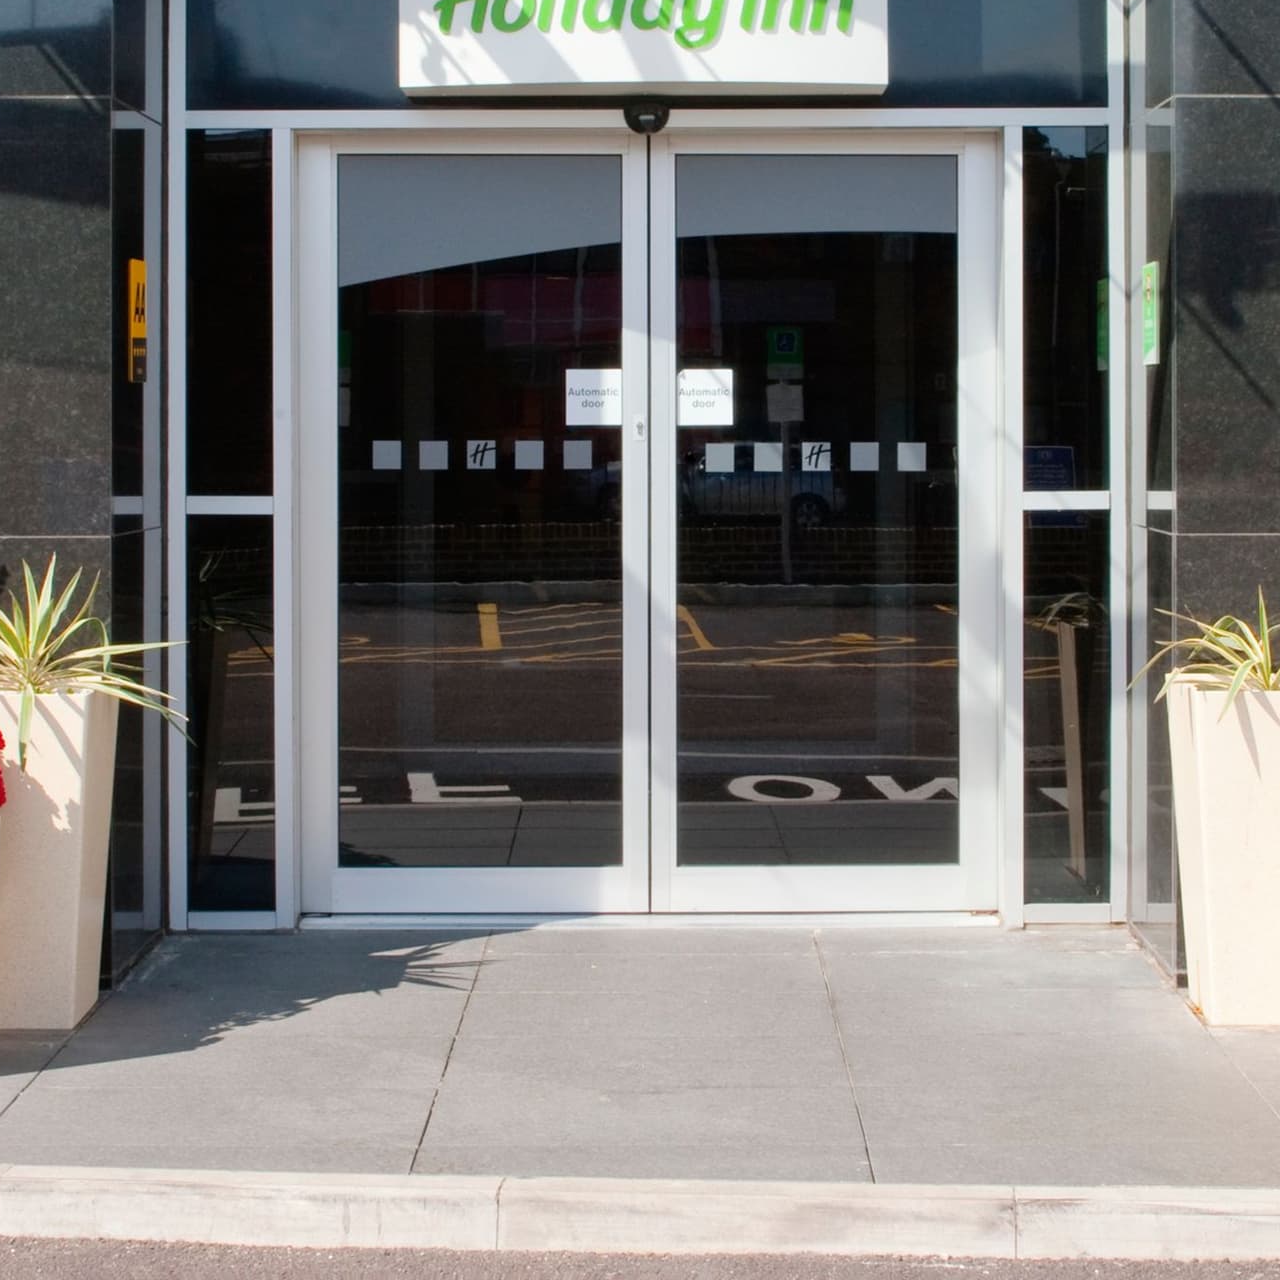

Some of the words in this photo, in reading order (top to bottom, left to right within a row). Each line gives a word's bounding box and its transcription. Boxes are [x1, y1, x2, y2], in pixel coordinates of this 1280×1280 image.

[568, 387, 620, 397] Automatic
[679, 387, 730, 397] Automatic
[581, 399, 606, 408] door
[692, 399, 716, 408] door
